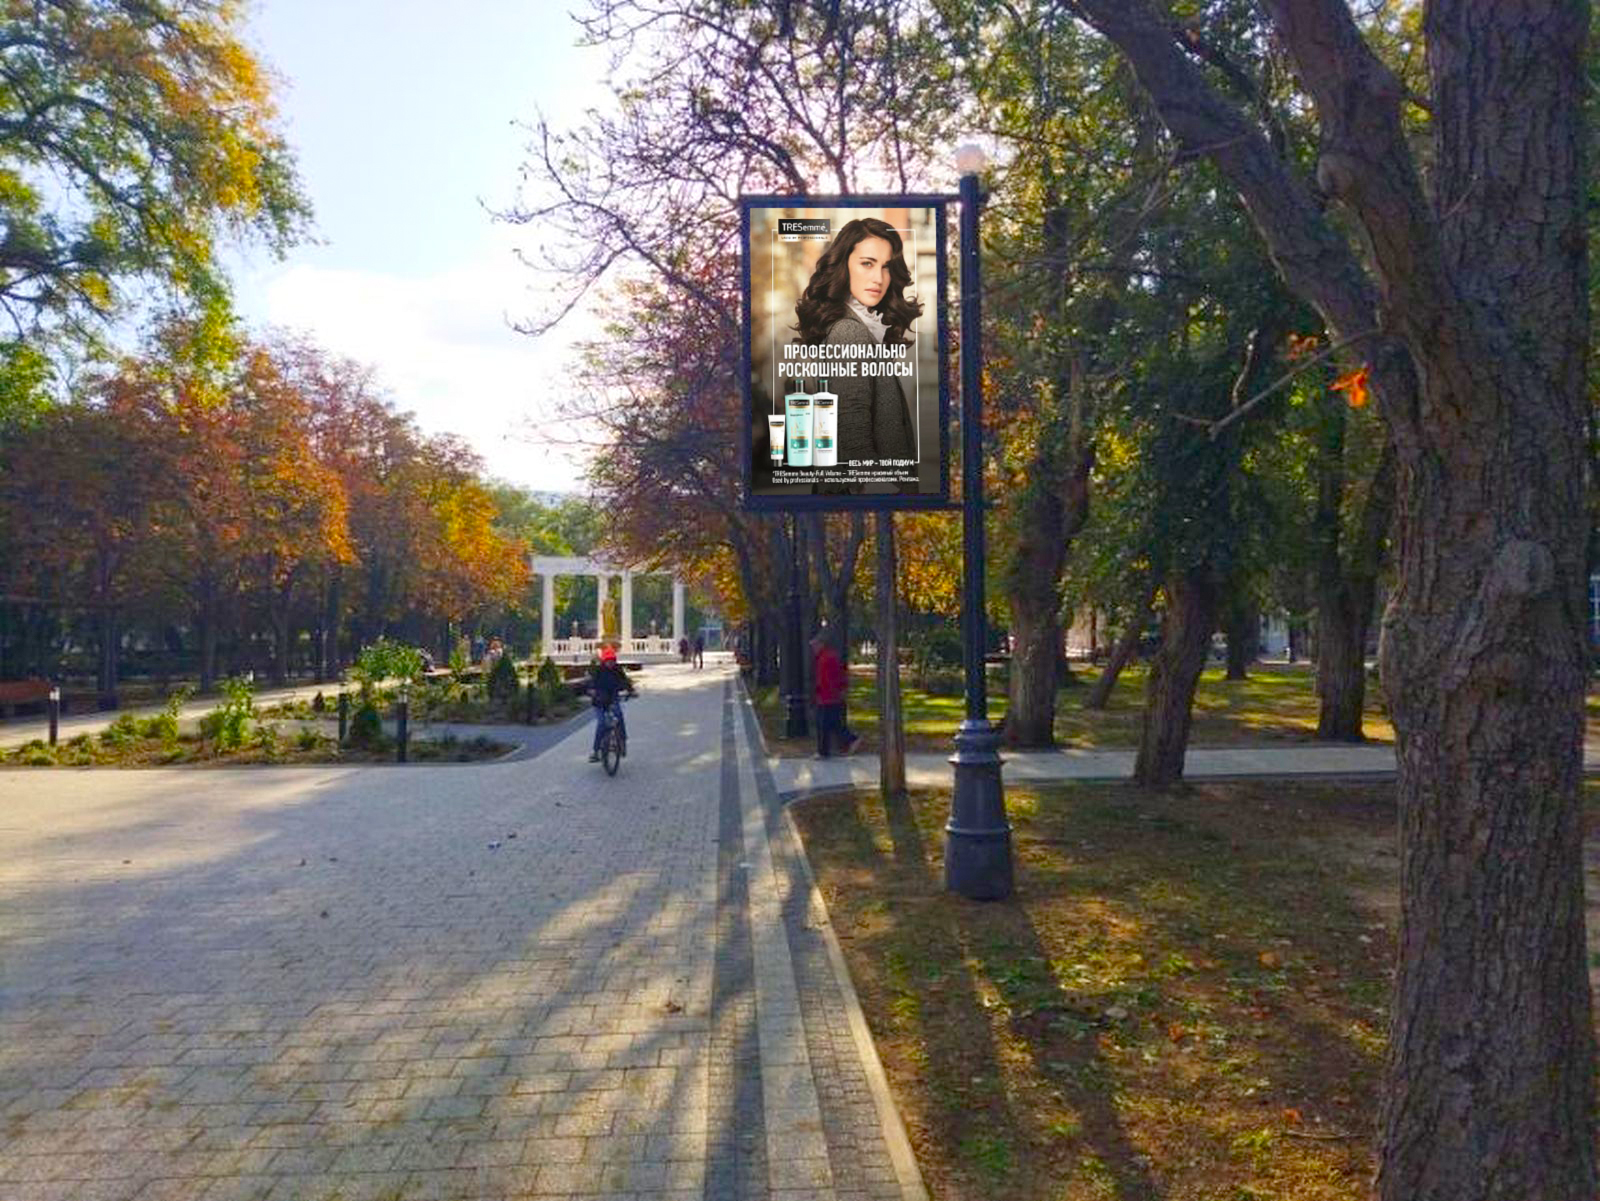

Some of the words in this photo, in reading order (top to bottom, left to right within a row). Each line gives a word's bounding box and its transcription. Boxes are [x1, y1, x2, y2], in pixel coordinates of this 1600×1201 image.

[784, 344, 907, 359] ПРОФЕССИОНАЛЬНО
[778, 362, 858, 377] РОСКОШНЫЕ
[861, 361, 913, 377] ВОЛОСЫ
[879, 458, 892, 467] ТВОЙ
[893, 459, 914, 467] ПОДИУМ
